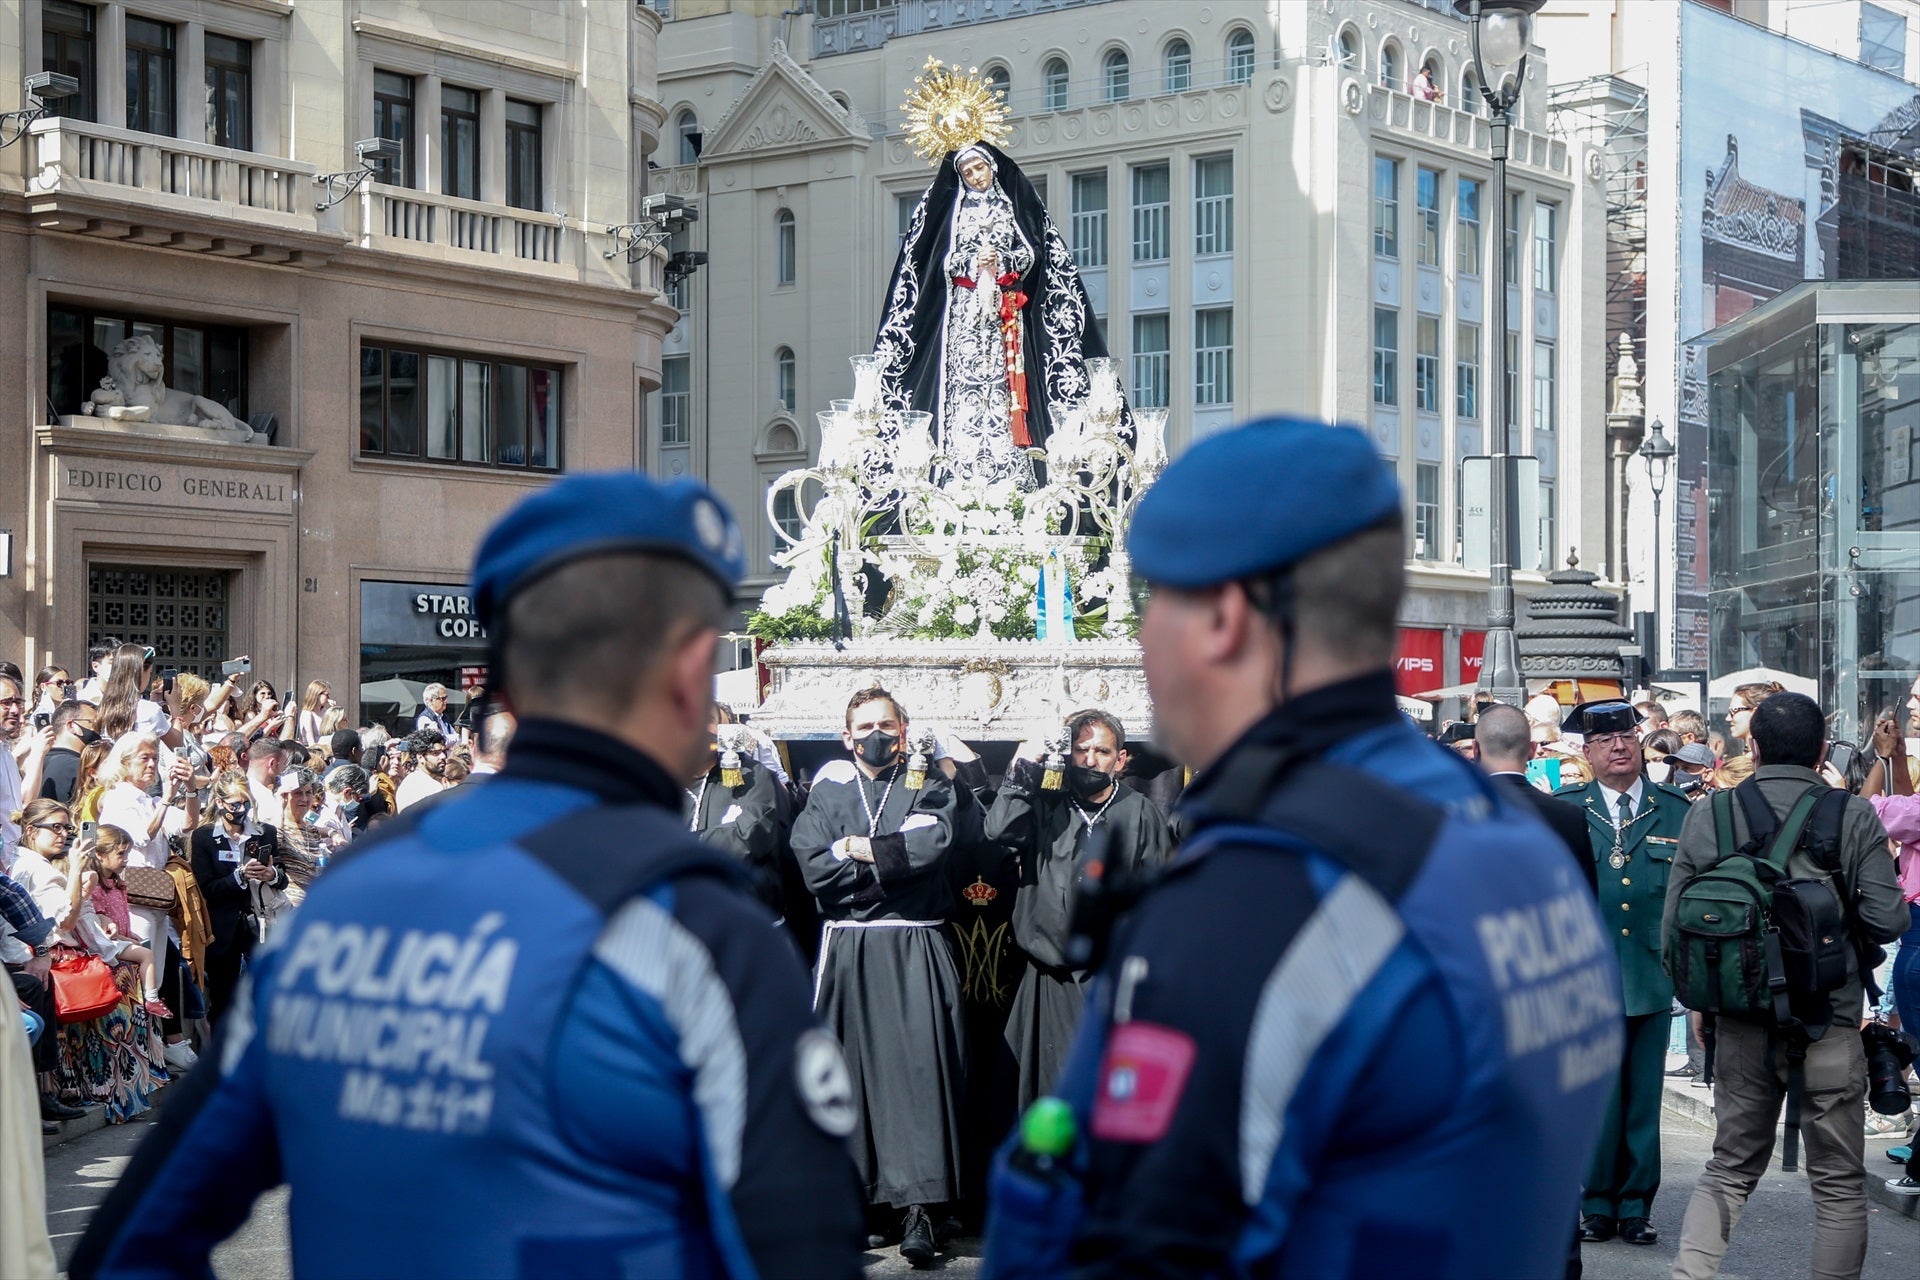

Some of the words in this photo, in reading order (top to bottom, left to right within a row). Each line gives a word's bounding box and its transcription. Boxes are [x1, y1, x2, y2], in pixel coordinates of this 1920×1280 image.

[67, 468, 162, 492] EDIFICIO
[183, 477, 285, 502] GENERALI
[304, 577, 318, 593] 21
[417, 594, 475, 615] STAR
[441, 618, 487, 638] COF
[278, 911, 518, 1014] POLICÍA
[267, 991, 496, 1081] MUNICIPAL
